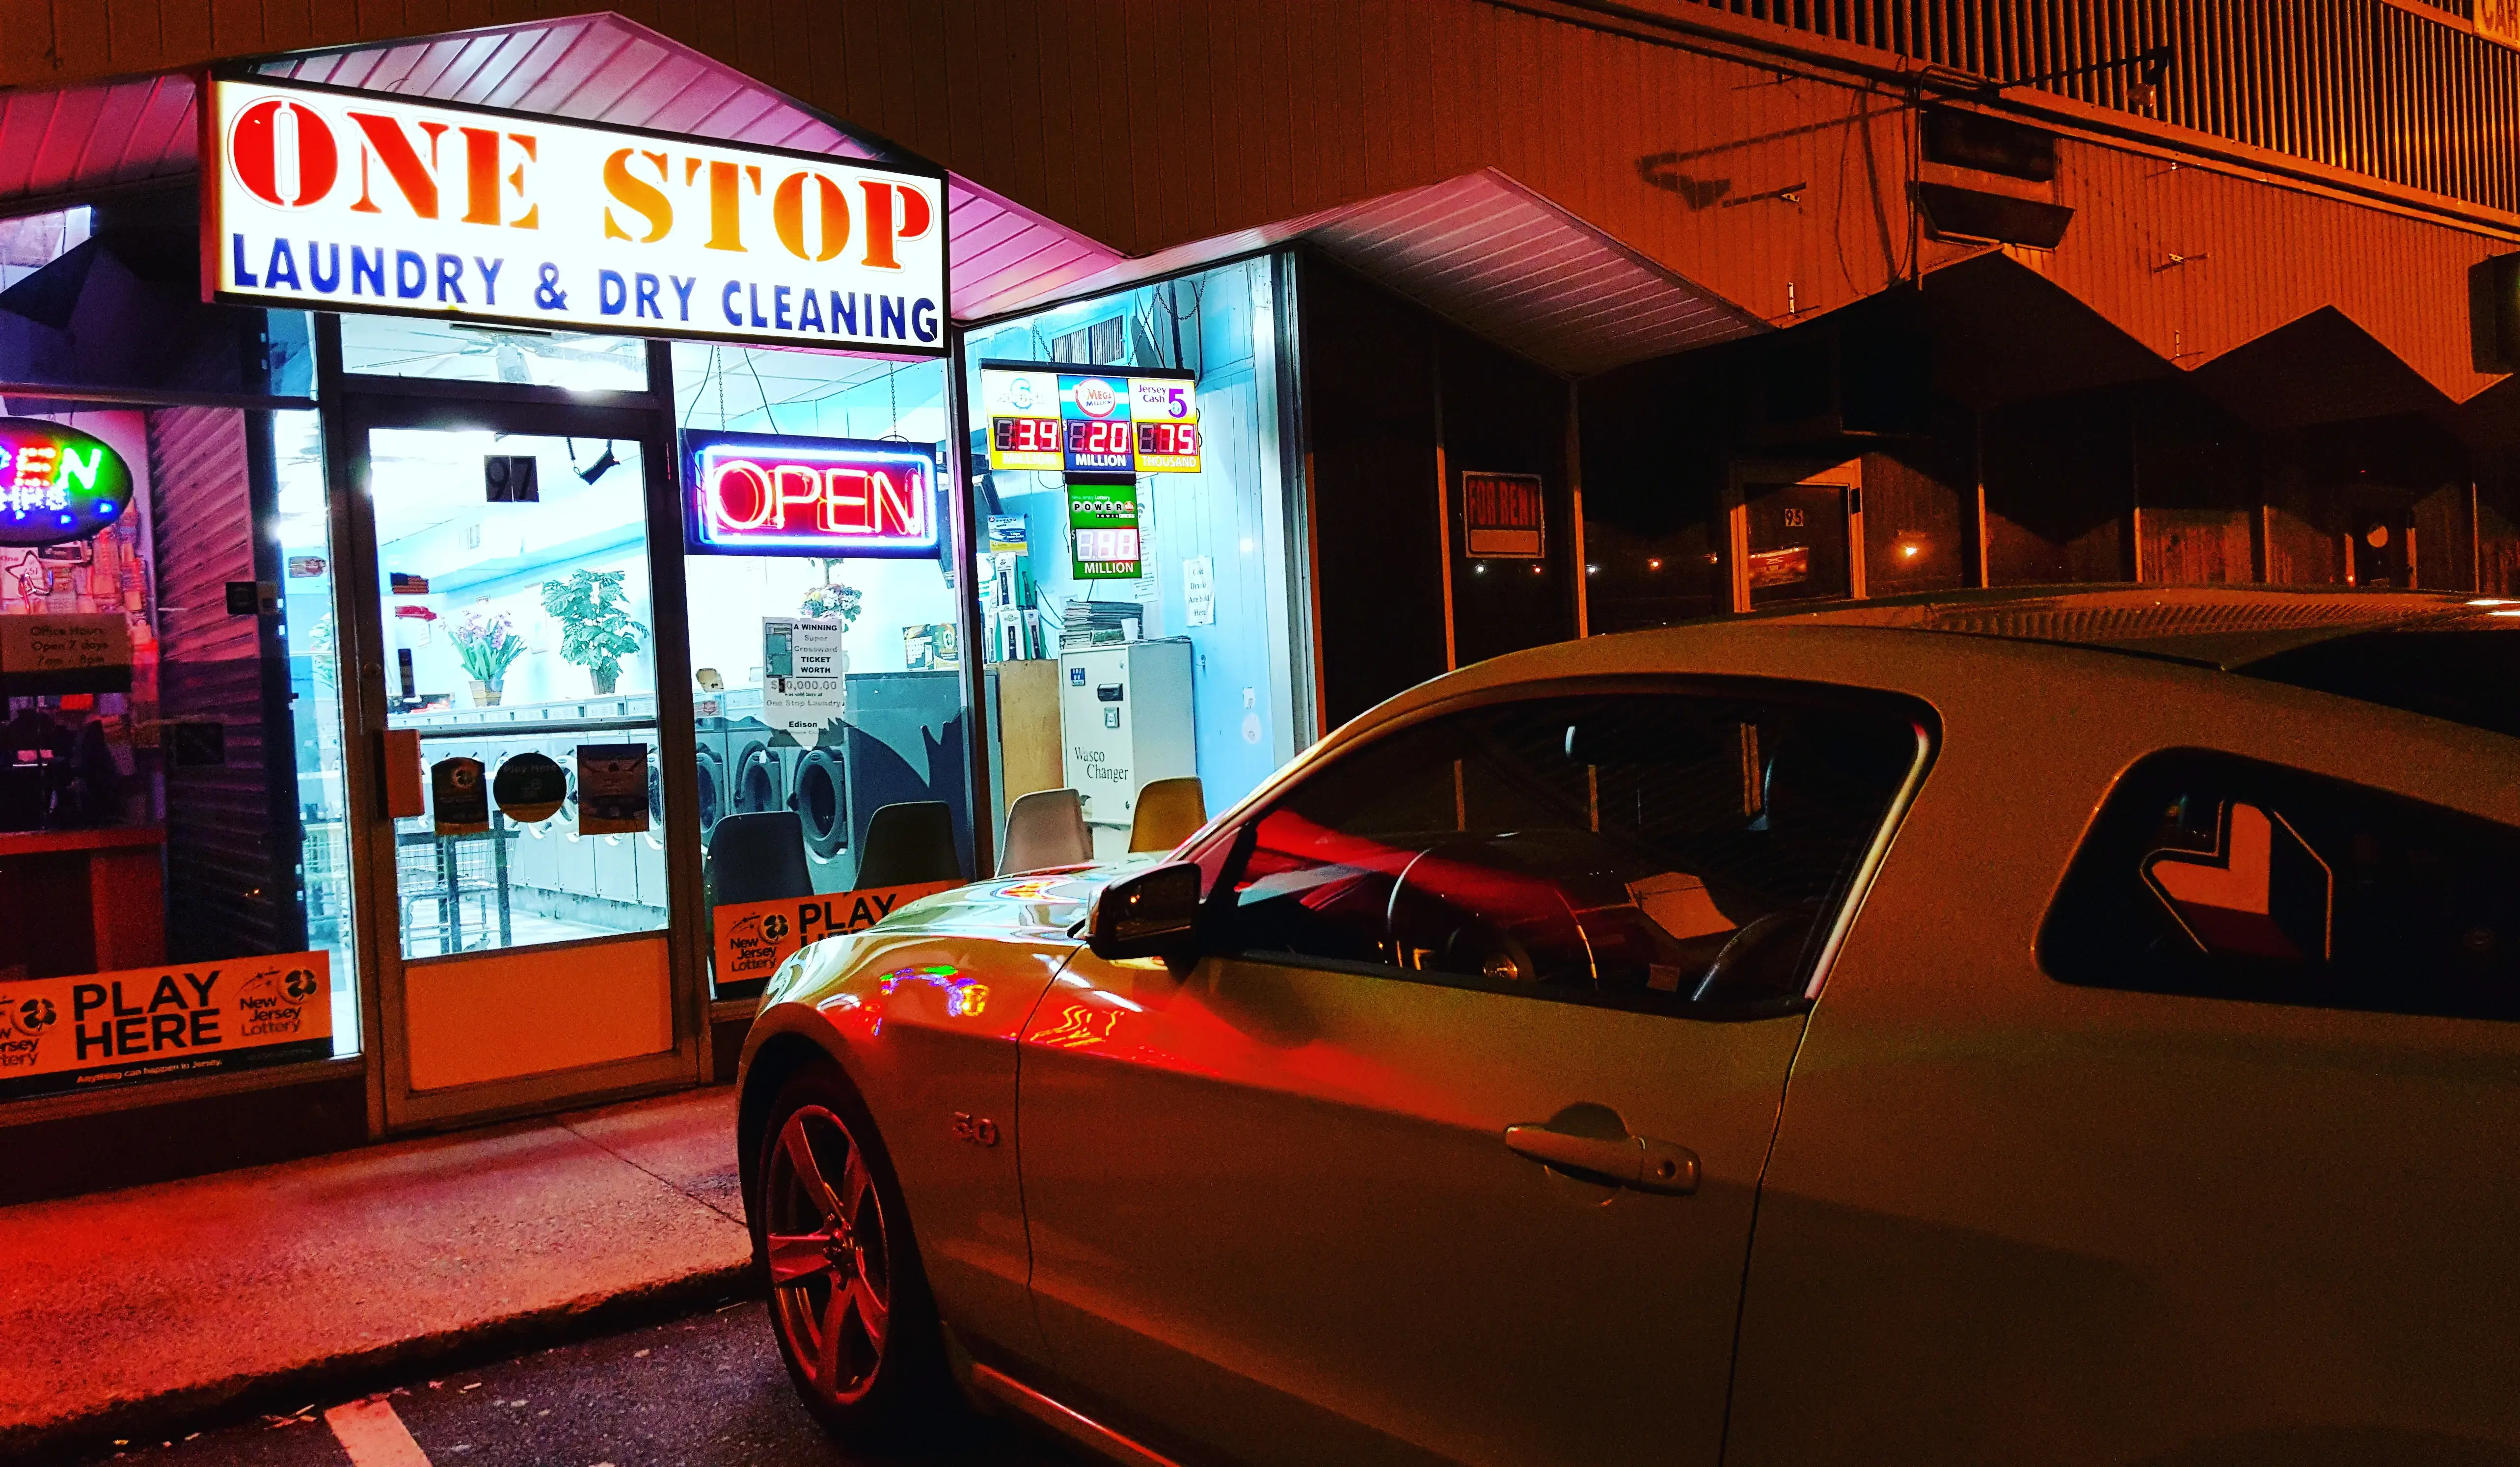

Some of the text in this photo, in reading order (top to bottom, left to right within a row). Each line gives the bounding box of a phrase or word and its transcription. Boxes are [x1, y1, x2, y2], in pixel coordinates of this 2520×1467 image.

[228, 97, 934, 271] ONE STOP
[233, 233, 938, 342] LAUNDRY & DRY CLEANING
[1086, 388, 1111, 400] MEGA
[1138, 384, 1166, 395] Jersey
[1143, 394, 1165, 403] Cash
[1168, 388, 1188, 418] 5
[1089, 422, 1128, 453] 20
[1160, 424, 1194, 454] 75
[1003, 452, 1057, 465] MILLION
[1076, 454, 1126, 467] MILLION
[1141, 455, 1197, 468] THOUSAND
[488, 457, 535, 500] 97
[713, 460, 923, 535] OPEN
[1468, 479, 1536, 526] FOR RENT
[1084, 562, 1134, 574] MILLION
[31, 640, 65, 652] Open
[81, 640, 108, 652] days
[804, 634, 828, 643] Super
[771, 680, 837, 691] $0,000.00
[808, 699, 840, 707] Laundry
[1075, 747, 1105, 762] Wasco
[1087, 763, 1129, 783] Changer
[799, 893, 897, 934] PLAY
[730, 937, 759, 950] New
[737, 946, 777, 960] Jersey
[732, 958, 777, 973] Lottery
[73, 970, 221, 1022] PLAY
[240, 996, 277, 1010] New
[249, 1006, 302, 1022] Jersey
[75, 1008, 222, 1060] HERE
[241, 1019, 301, 1037] Lottery
[0, 1052, 39, 1066] tery
